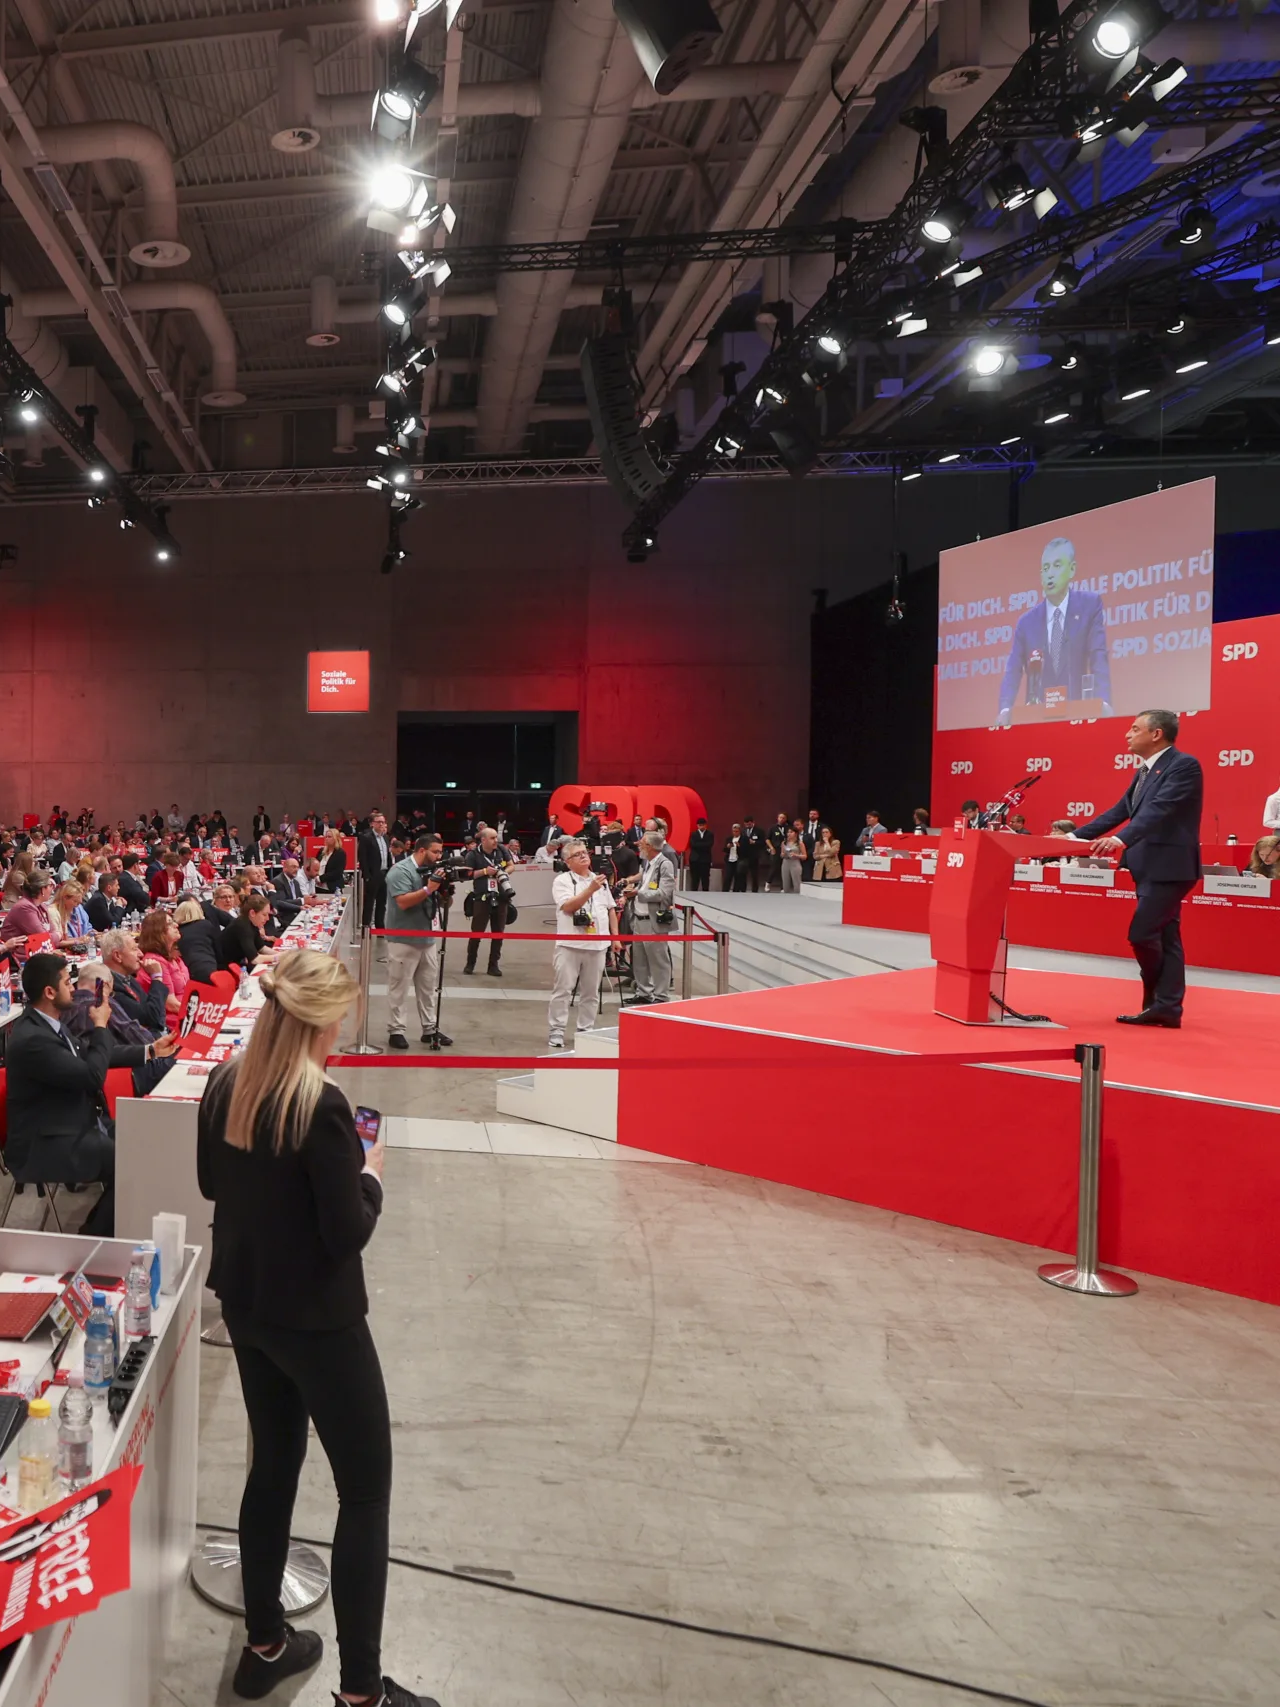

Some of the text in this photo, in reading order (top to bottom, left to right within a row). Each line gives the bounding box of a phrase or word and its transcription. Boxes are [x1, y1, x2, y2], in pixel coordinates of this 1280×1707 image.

[939, 602, 964, 624] FÜR
[967, 597, 1005, 621] DICH.
[1009, 590, 1038, 611] SPD
[1112, 560, 1183, 592] POLITIK
[1188, 549, 1213, 578] FÜ
[946, 631, 981, 652] DICH.
[984, 625, 1012, 645] SPD
[1103, 601, 1149, 626] LITIK
[1153, 591, 1190, 619] FÜR
[1112, 636, 1148, 659] SPD
[1153, 626, 1211, 654] SOZIA
[1222, 642, 1258, 662] SPD
[321, 677, 356, 685] Politik für
[1026, 757, 1052, 772] SPD
[1114, 753, 1145, 770] SPD
[1218, 749, 1254, 767] SPD
[951, 761, 973, 775] SPD
[1066, 801, 1095, 817] SPD
[947, 852, 965, 868] SPD
[490, 880, 496, 888] B
[196, 1001, 228, 1024] FREE
[37, 1521, 94, 1610] FREE
